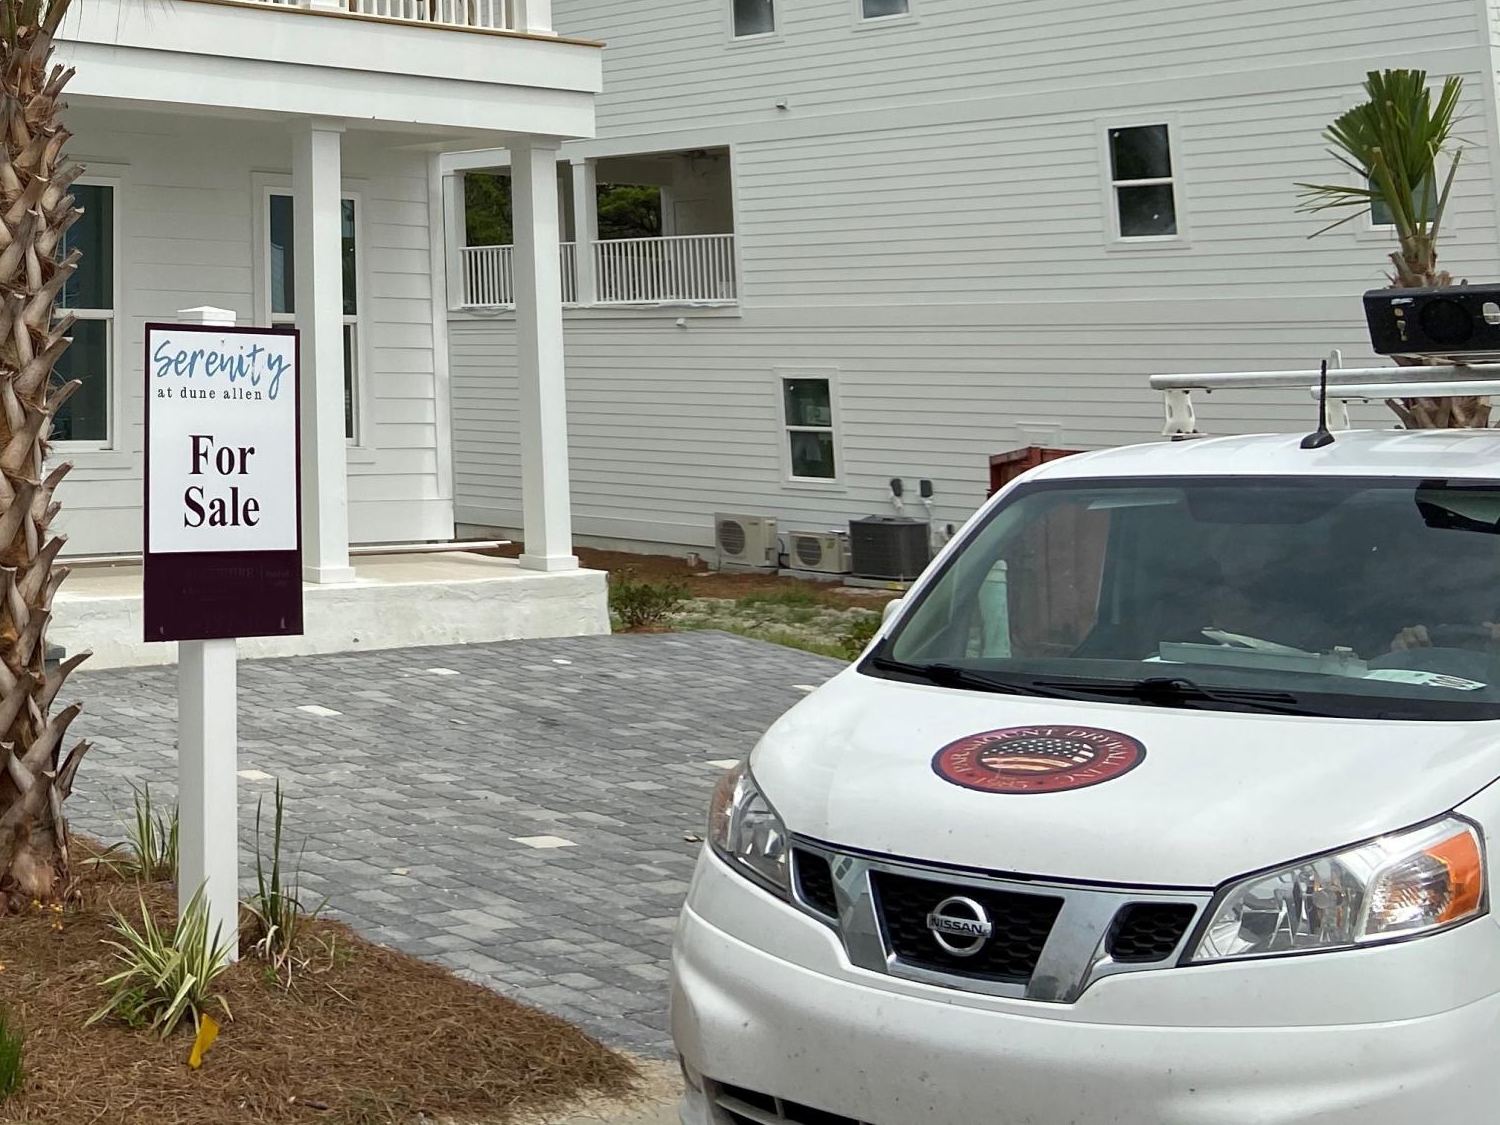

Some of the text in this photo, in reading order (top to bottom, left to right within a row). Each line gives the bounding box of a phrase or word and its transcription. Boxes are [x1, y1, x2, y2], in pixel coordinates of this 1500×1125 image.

[154, 340, 292, 401] Serenity
[157, 386, 262, 400] at dune allen
[188, 434, 256, 476] For
[184, 485, 261, 528] Sale
[950, 728, 1058, 773] PARAMOUNT
[1065, 730, 1128, 766] DRYWALL
[931, 917, 983, 935] NISSAN
